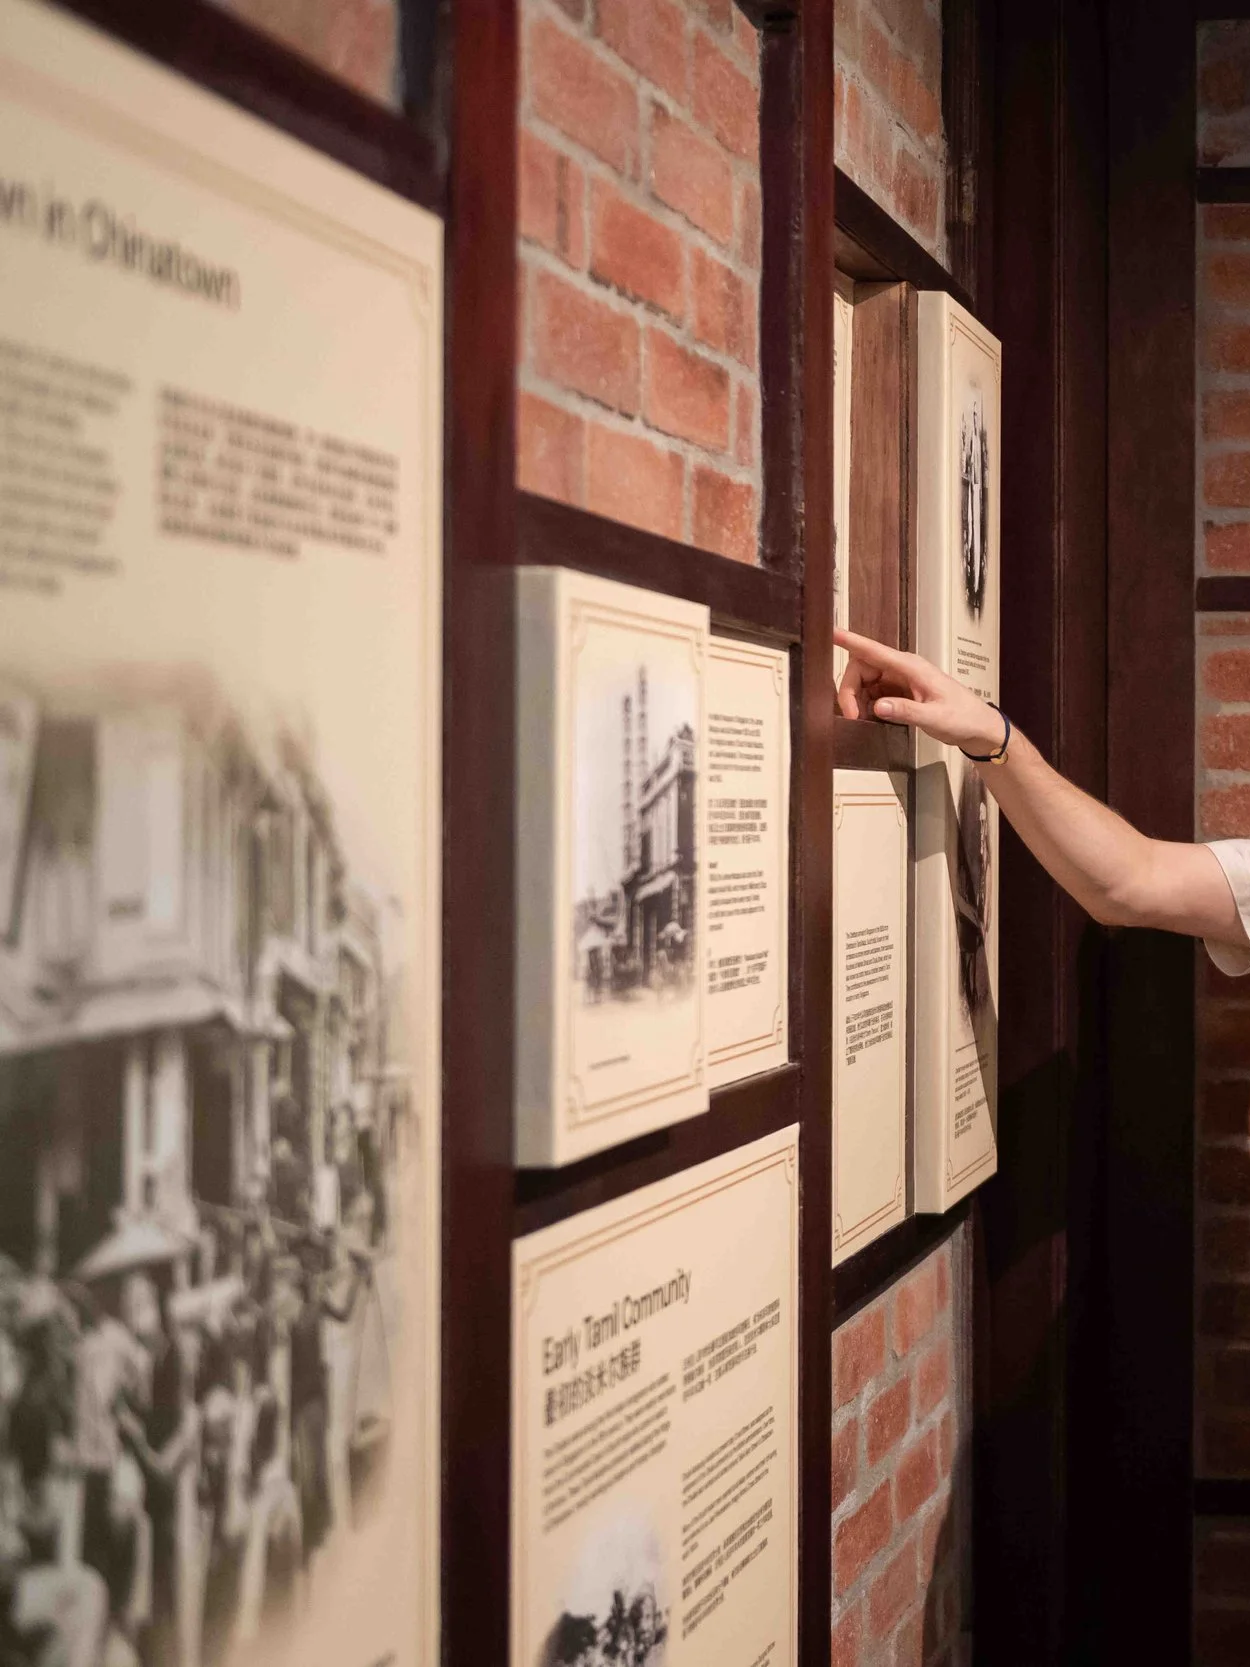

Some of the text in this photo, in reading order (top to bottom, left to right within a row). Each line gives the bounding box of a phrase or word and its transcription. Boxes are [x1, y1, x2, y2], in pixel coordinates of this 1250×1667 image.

[543, 1268, 692, 1375] Early Tamil Community
